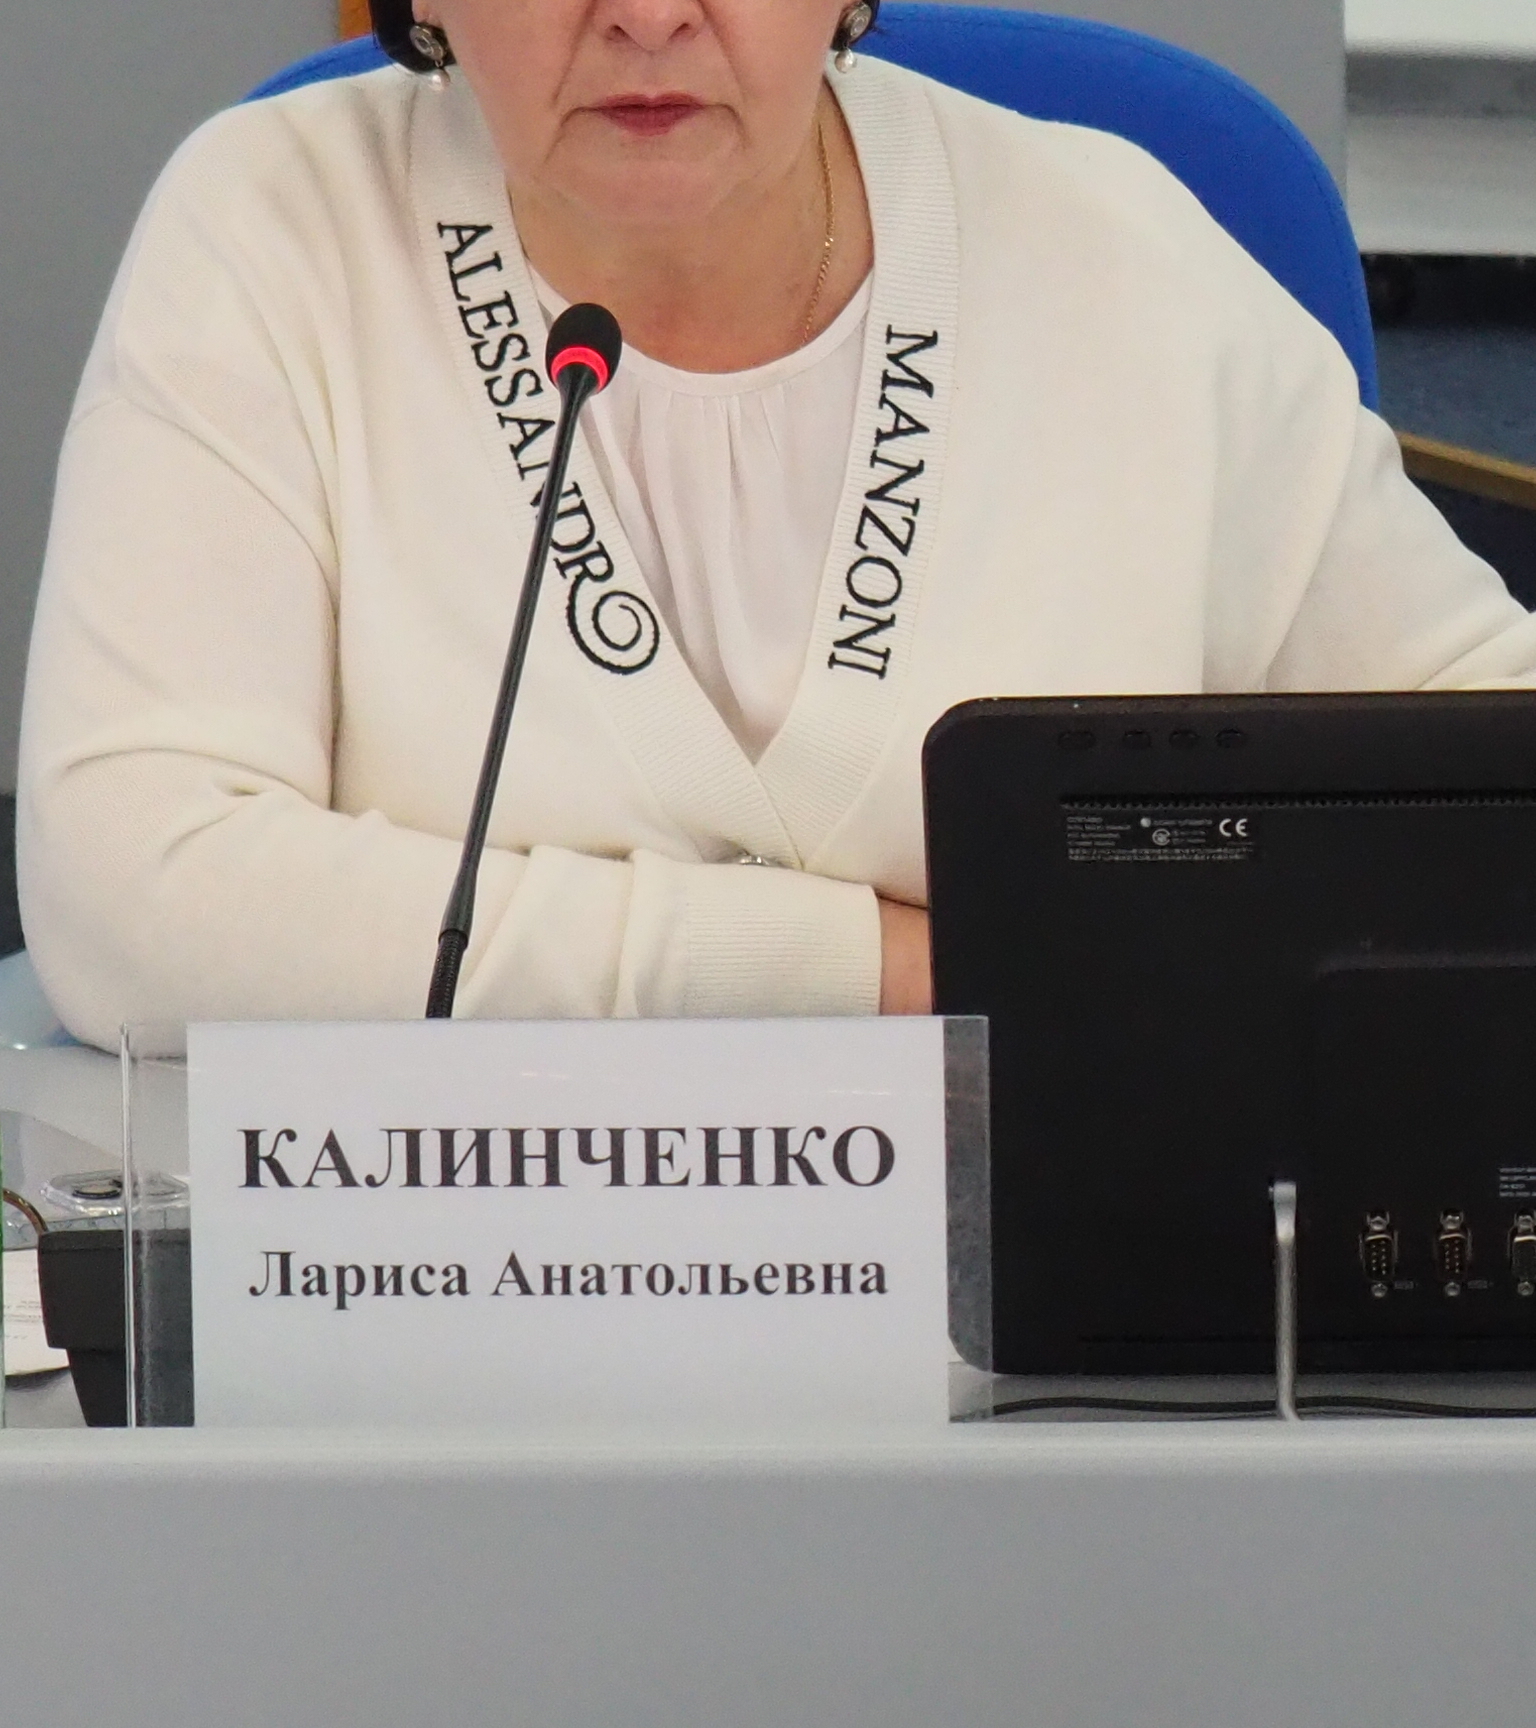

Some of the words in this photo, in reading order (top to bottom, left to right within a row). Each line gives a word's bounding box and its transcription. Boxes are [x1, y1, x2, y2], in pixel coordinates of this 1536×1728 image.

[827, 324, 939, 680] MANZONI
[238, 1124, 896, 1189] КАЛИНЧЕНКО
[249, 1250, 470, 1311] Лариса
[490, 1251, 888, 1297] Анатольевна
